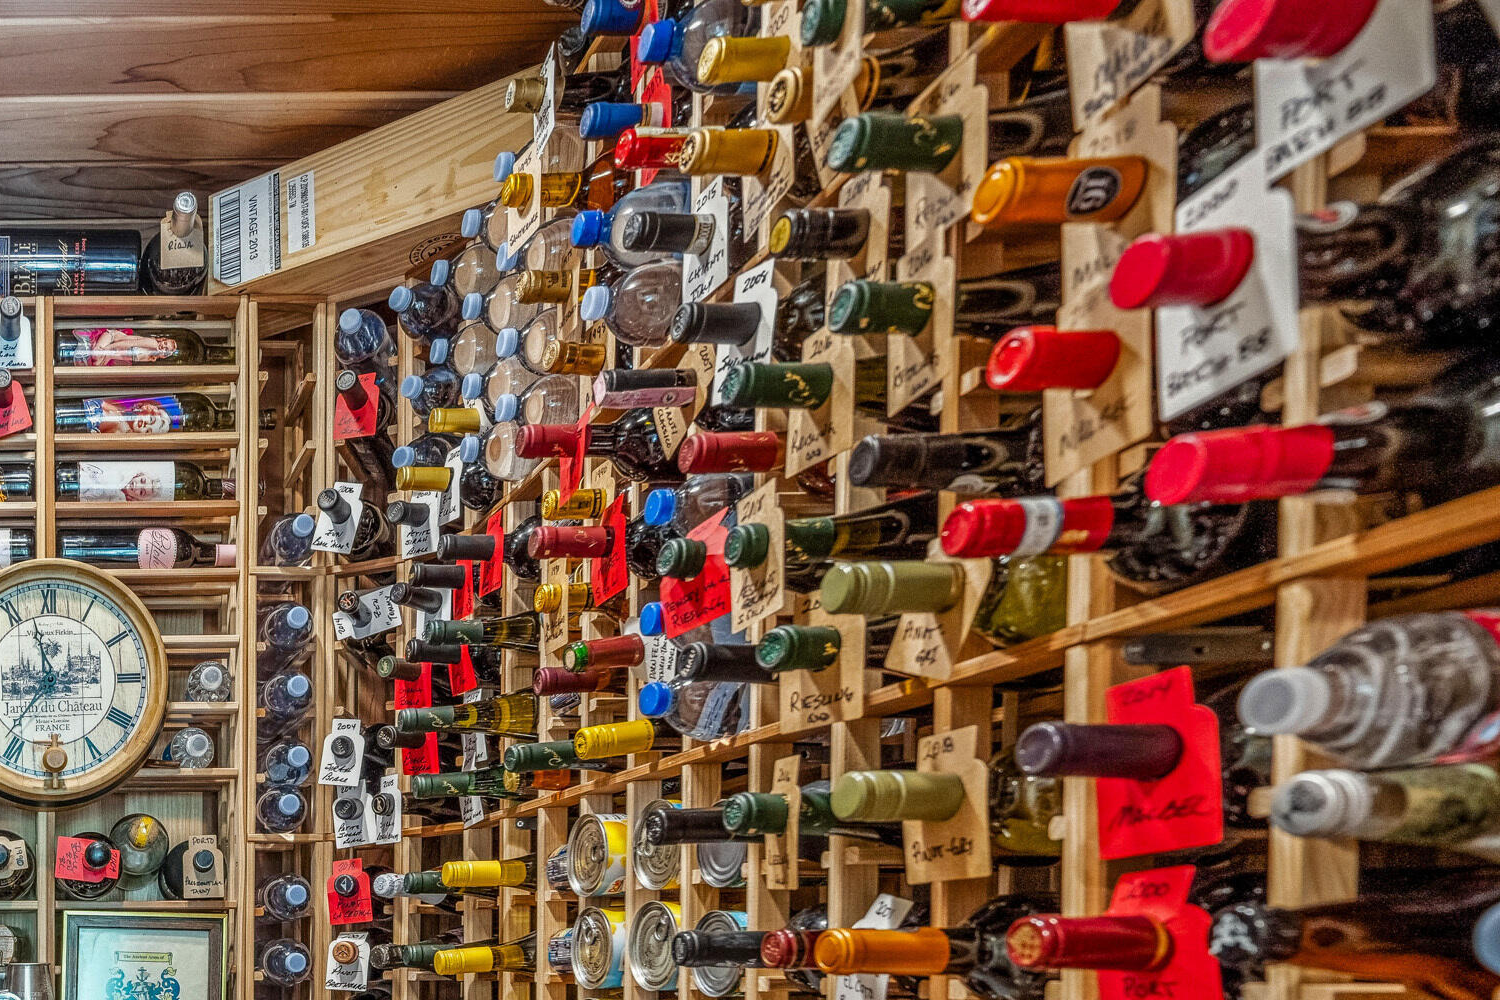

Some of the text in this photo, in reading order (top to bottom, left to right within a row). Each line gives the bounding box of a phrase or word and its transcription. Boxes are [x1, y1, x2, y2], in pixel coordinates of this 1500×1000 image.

[248, 194, 258, 261] VINTAGE 2013
[40, 588, 57, 614] XII
[82, 599, 95, 622] I
[0, 599, 22, 627] XI
[106, 630, 129, 648] II
[117, 673, 141, 684] III
[3, 699, 103, 716] Jardin du Château
[106, 707, 133, 730] IIII
[35, 723, 71, 732] FRANCE
[337, 722, 356, 731] 2004
[2, 736, 26, 764] VII
[85, 736, 103, 760] V
[191, 837, 215, 845] PORTO
